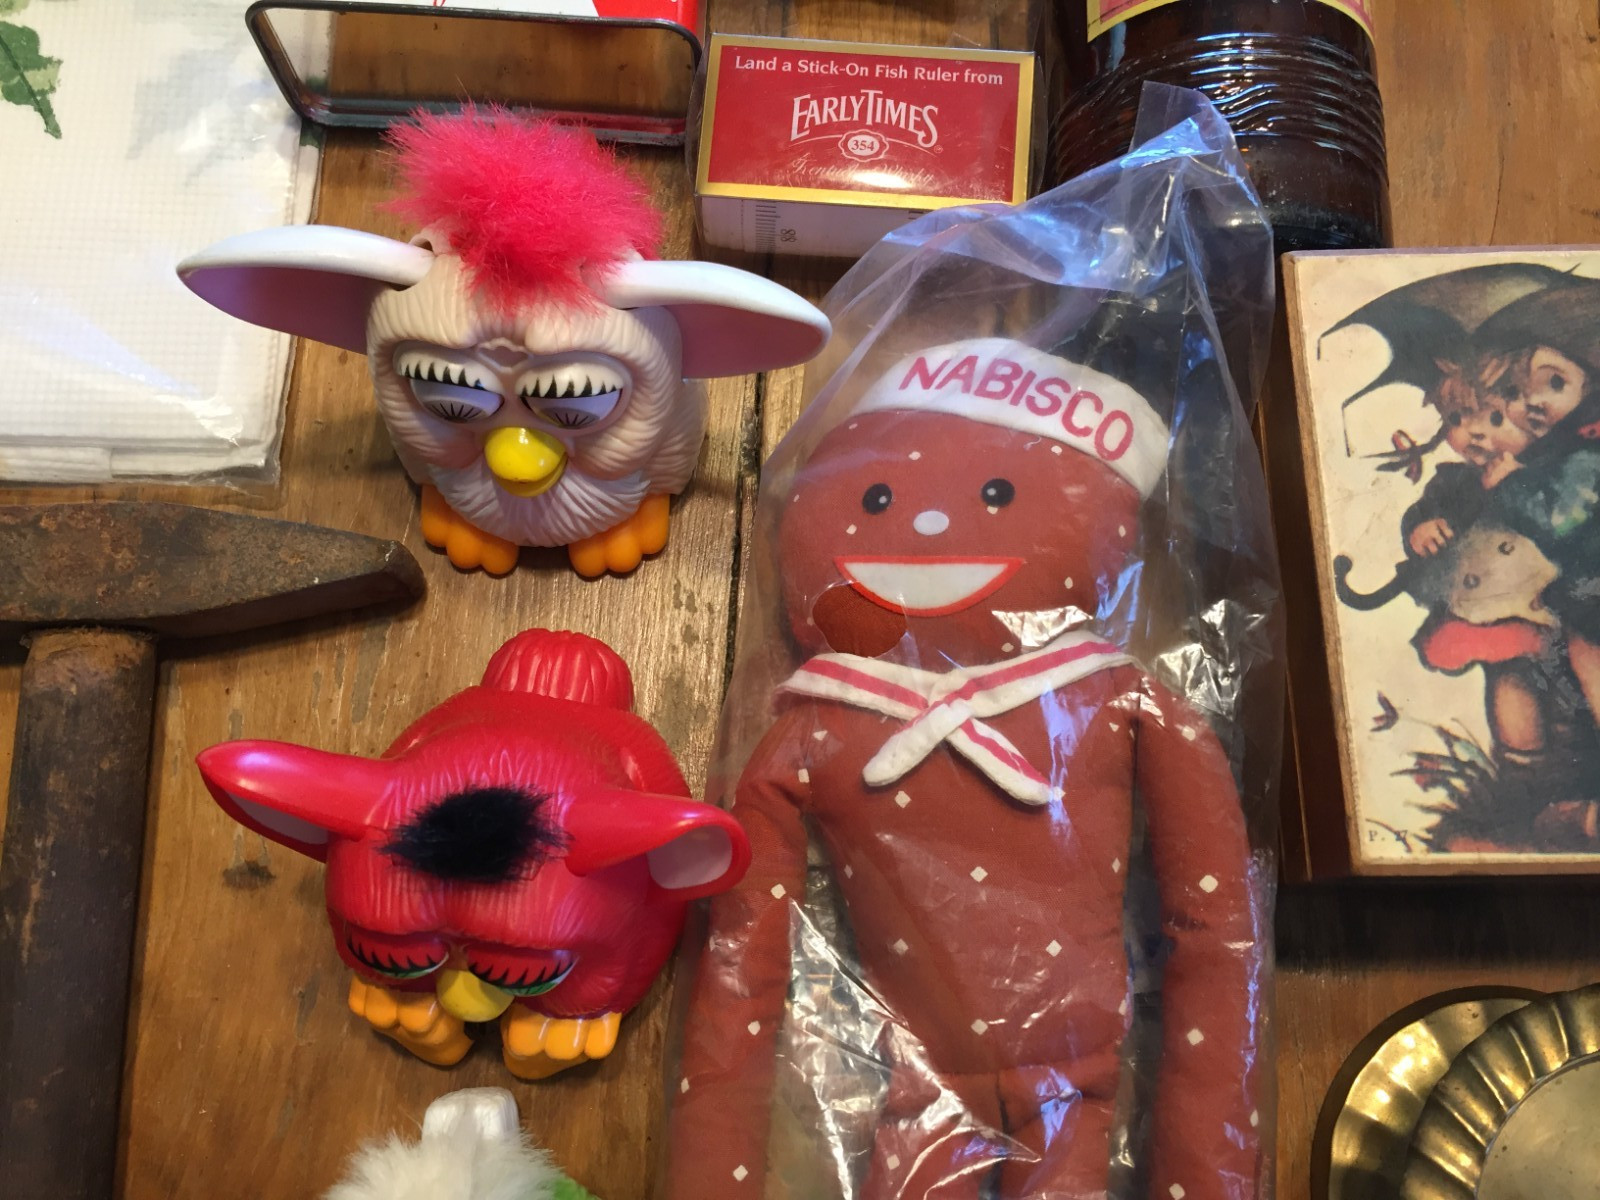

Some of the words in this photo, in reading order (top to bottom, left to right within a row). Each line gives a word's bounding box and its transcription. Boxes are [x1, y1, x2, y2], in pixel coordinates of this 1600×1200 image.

[735, 56, 777, 72] Land
[782, 62, 792, 73] a
[798, 60, 869, 77] Stick-On
[875, 65, 907, 79] Fish
[914, 67, 957, 83] Ruler
[964, 69, 1003, 85] from
[851, 140, 875, 151] 354
[899, 356, 1134, 462] NABISCO
